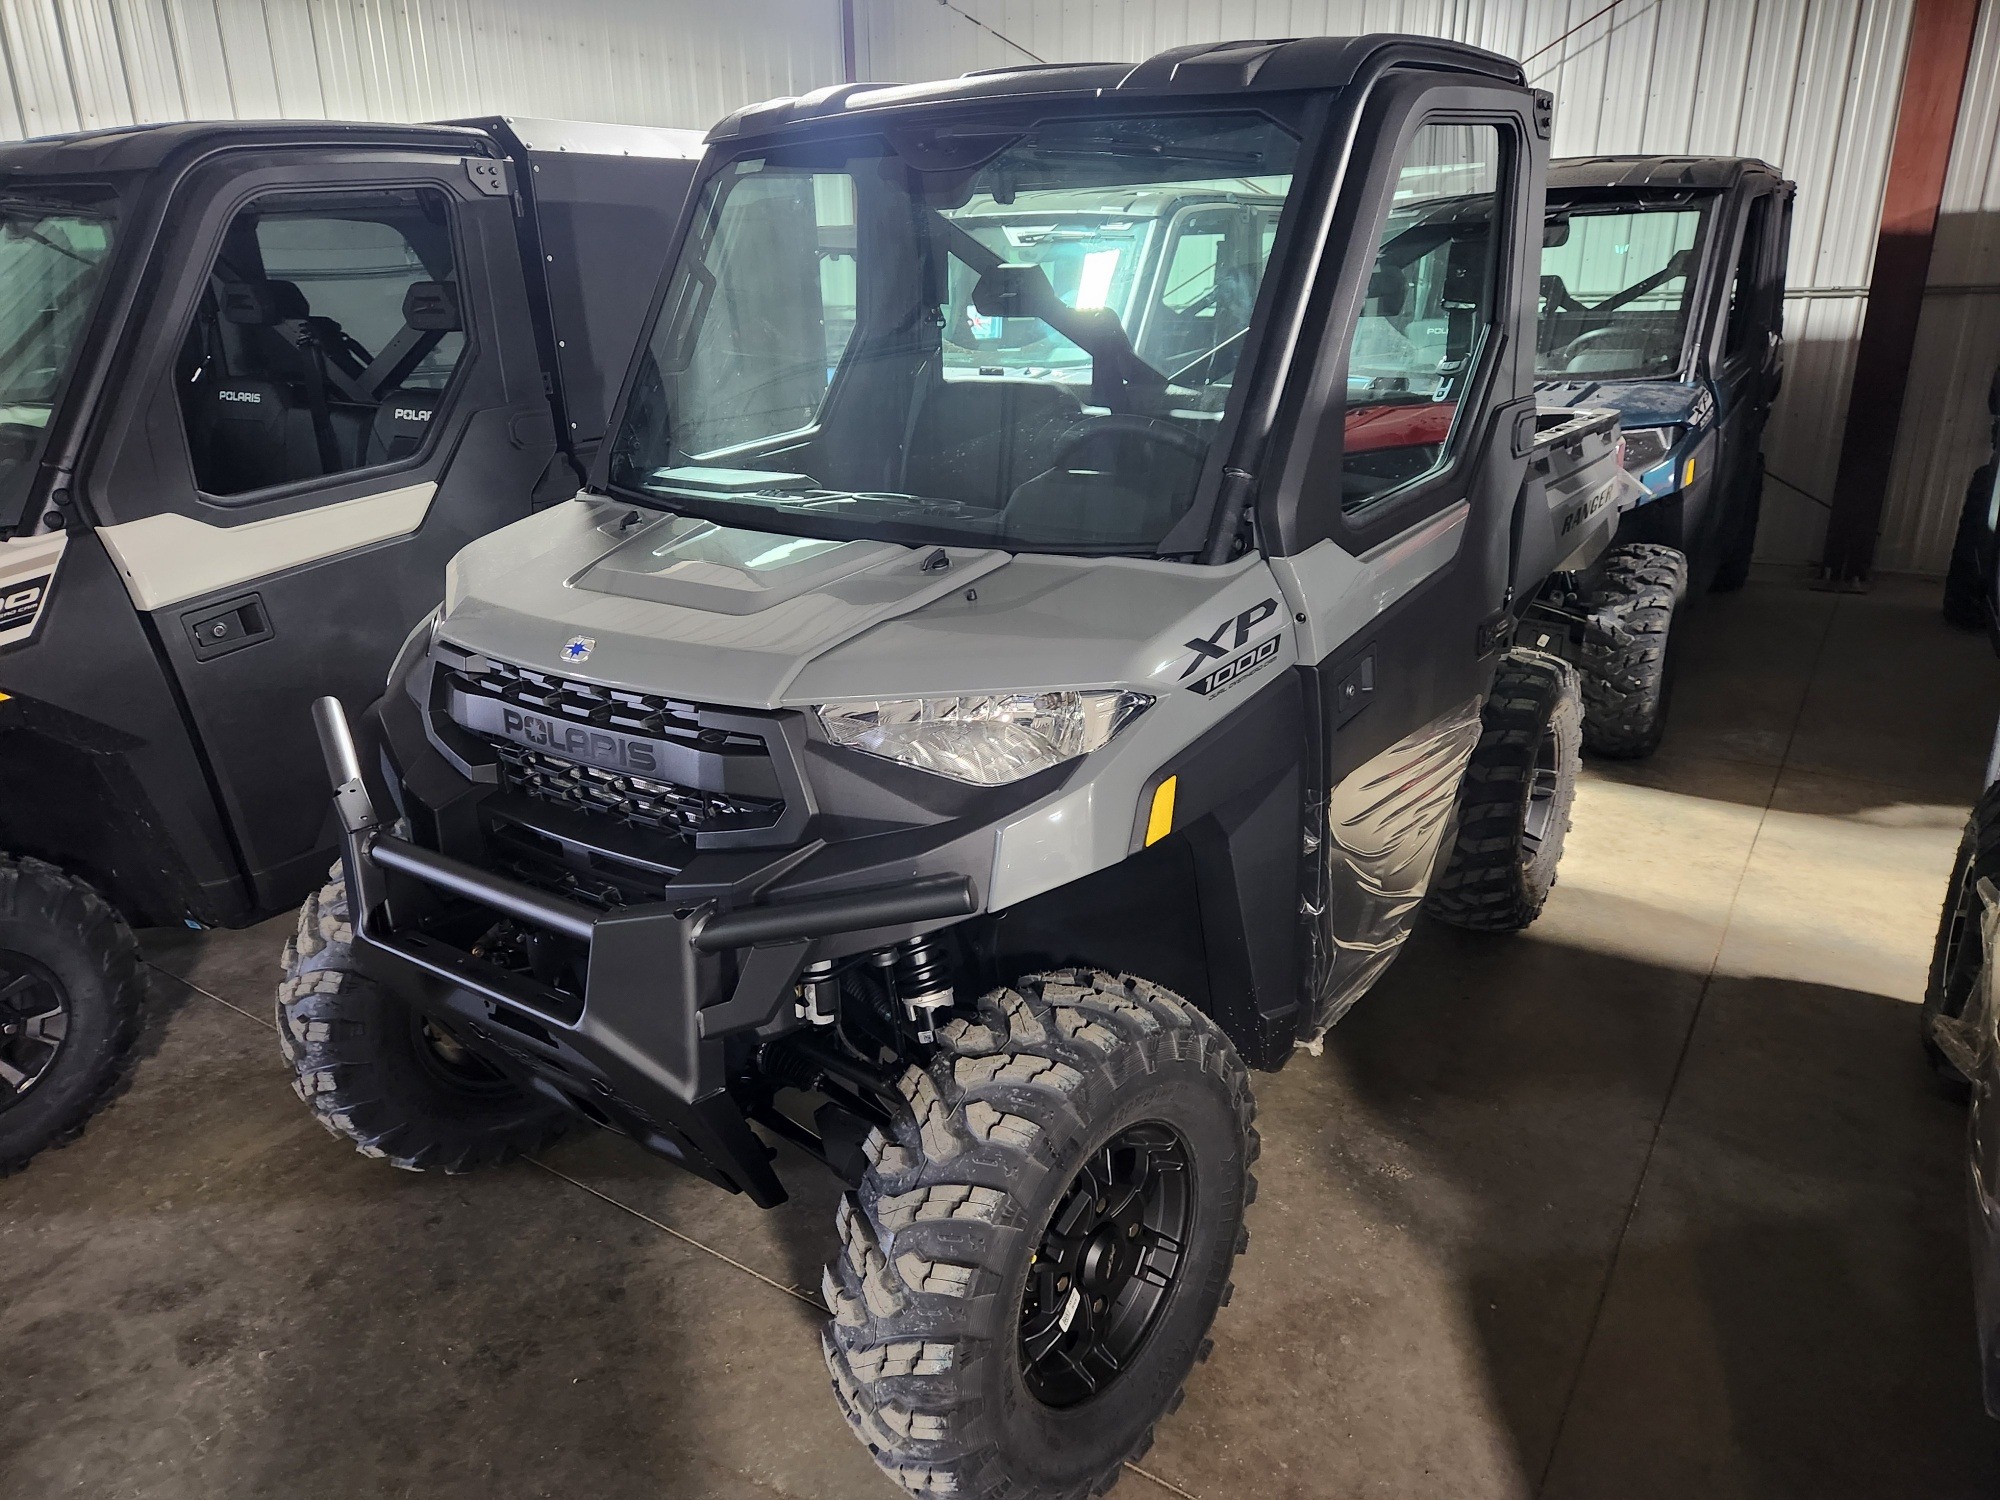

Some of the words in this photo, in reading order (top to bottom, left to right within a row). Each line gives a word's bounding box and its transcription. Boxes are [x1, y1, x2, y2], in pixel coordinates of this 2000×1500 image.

[1426, 327, 1449, 335] POL
[219, 390, 261, 403] POLARIS
[1561, 483, 1615, 536] RANGER
[1177, 597, 1279, 681] XP
[1204, 638, 1277, 693] 1000
[502, 707, 657, 773] POLARIS
